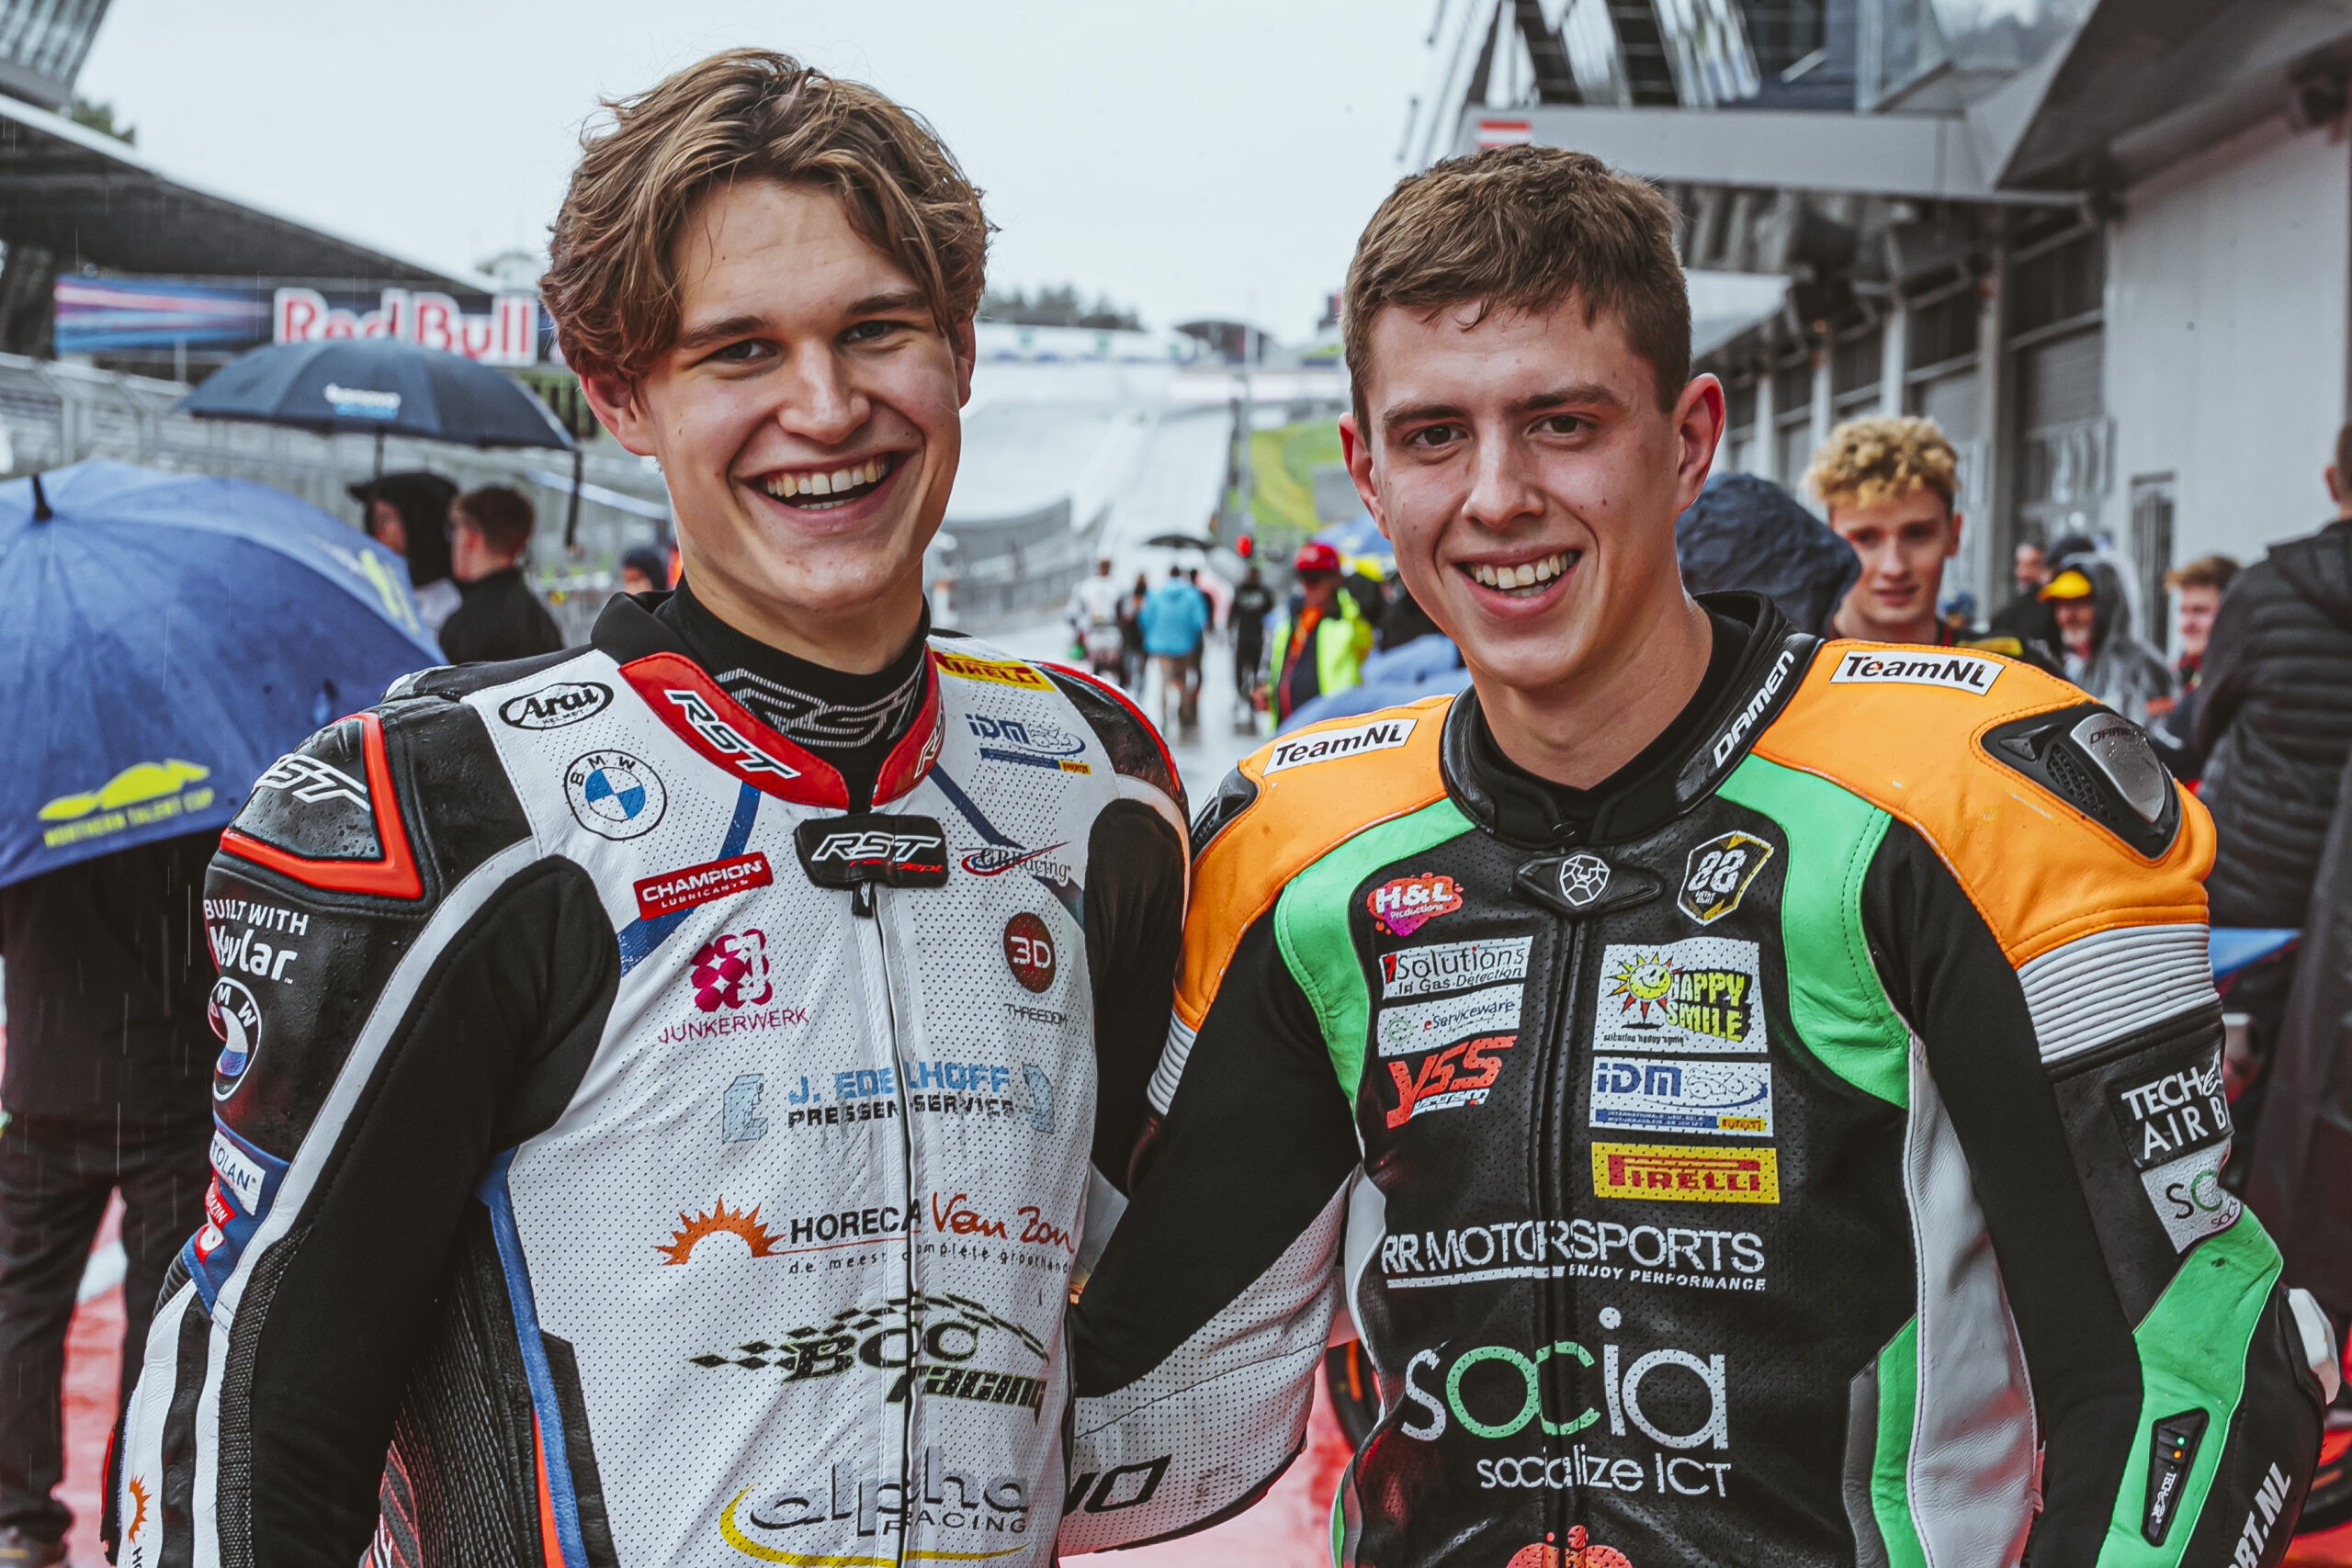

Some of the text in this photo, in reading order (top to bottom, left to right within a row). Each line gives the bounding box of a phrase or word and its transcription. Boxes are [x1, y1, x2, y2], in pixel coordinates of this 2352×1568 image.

[413, 294, 532, 362] Bull
[1847, 656, 1986, 688] TeamNL
[512, 688, 599, 726] Arai
[1713, 650, 1794, 768] DAMEN
[663, 690, 801, 780] RST
[1276, 724, 1403, 766] TeamNL
[810, 830, 942, 862] RST
[642, 860, 763, 903] CHAMPION
[1688, 849, 1747, 894] 88
[661, 879, 749, 908] LUBRICANTS
[1375, 883, 1453, 914] H&L
[1390, 903, 1444, 919] Productions
[202, 899, 310, 937] BUILT WITH
[1011, 935, 1052, 969] 3D
[1419, 976, 1451, 992] Gas
[1456, 965, 1522, 987] Detection
[1668, 972, 1745, 1007] HAPPY
[659, 1007, 809, 1043] JUNKERWERK
[1665, 1001, 1743, 1043] SMILE
[788, 1061, 1010, 1105] J. EDELHOFF
[2143, 1105, 2209, 1160] AIR
[1608, 1155, 1761, 1191] PIRELLI
[791, 1191, 1075, 1255] HORECA Van Zon
[1381, 1218, 1766, 1274] RR MOTORSPORTS
[788, 1260, 813, 1275] de
[1568, 1264, 1767, 1292] ENJOY PERFORMANCE
[1401, 1306, 1729, 1450] socia
[1476, 1443, 1732, 1498] socialize ICT
[750, 1446, 1028, 1538] alpha
[884, 1511, 1028, 1535] RACING
